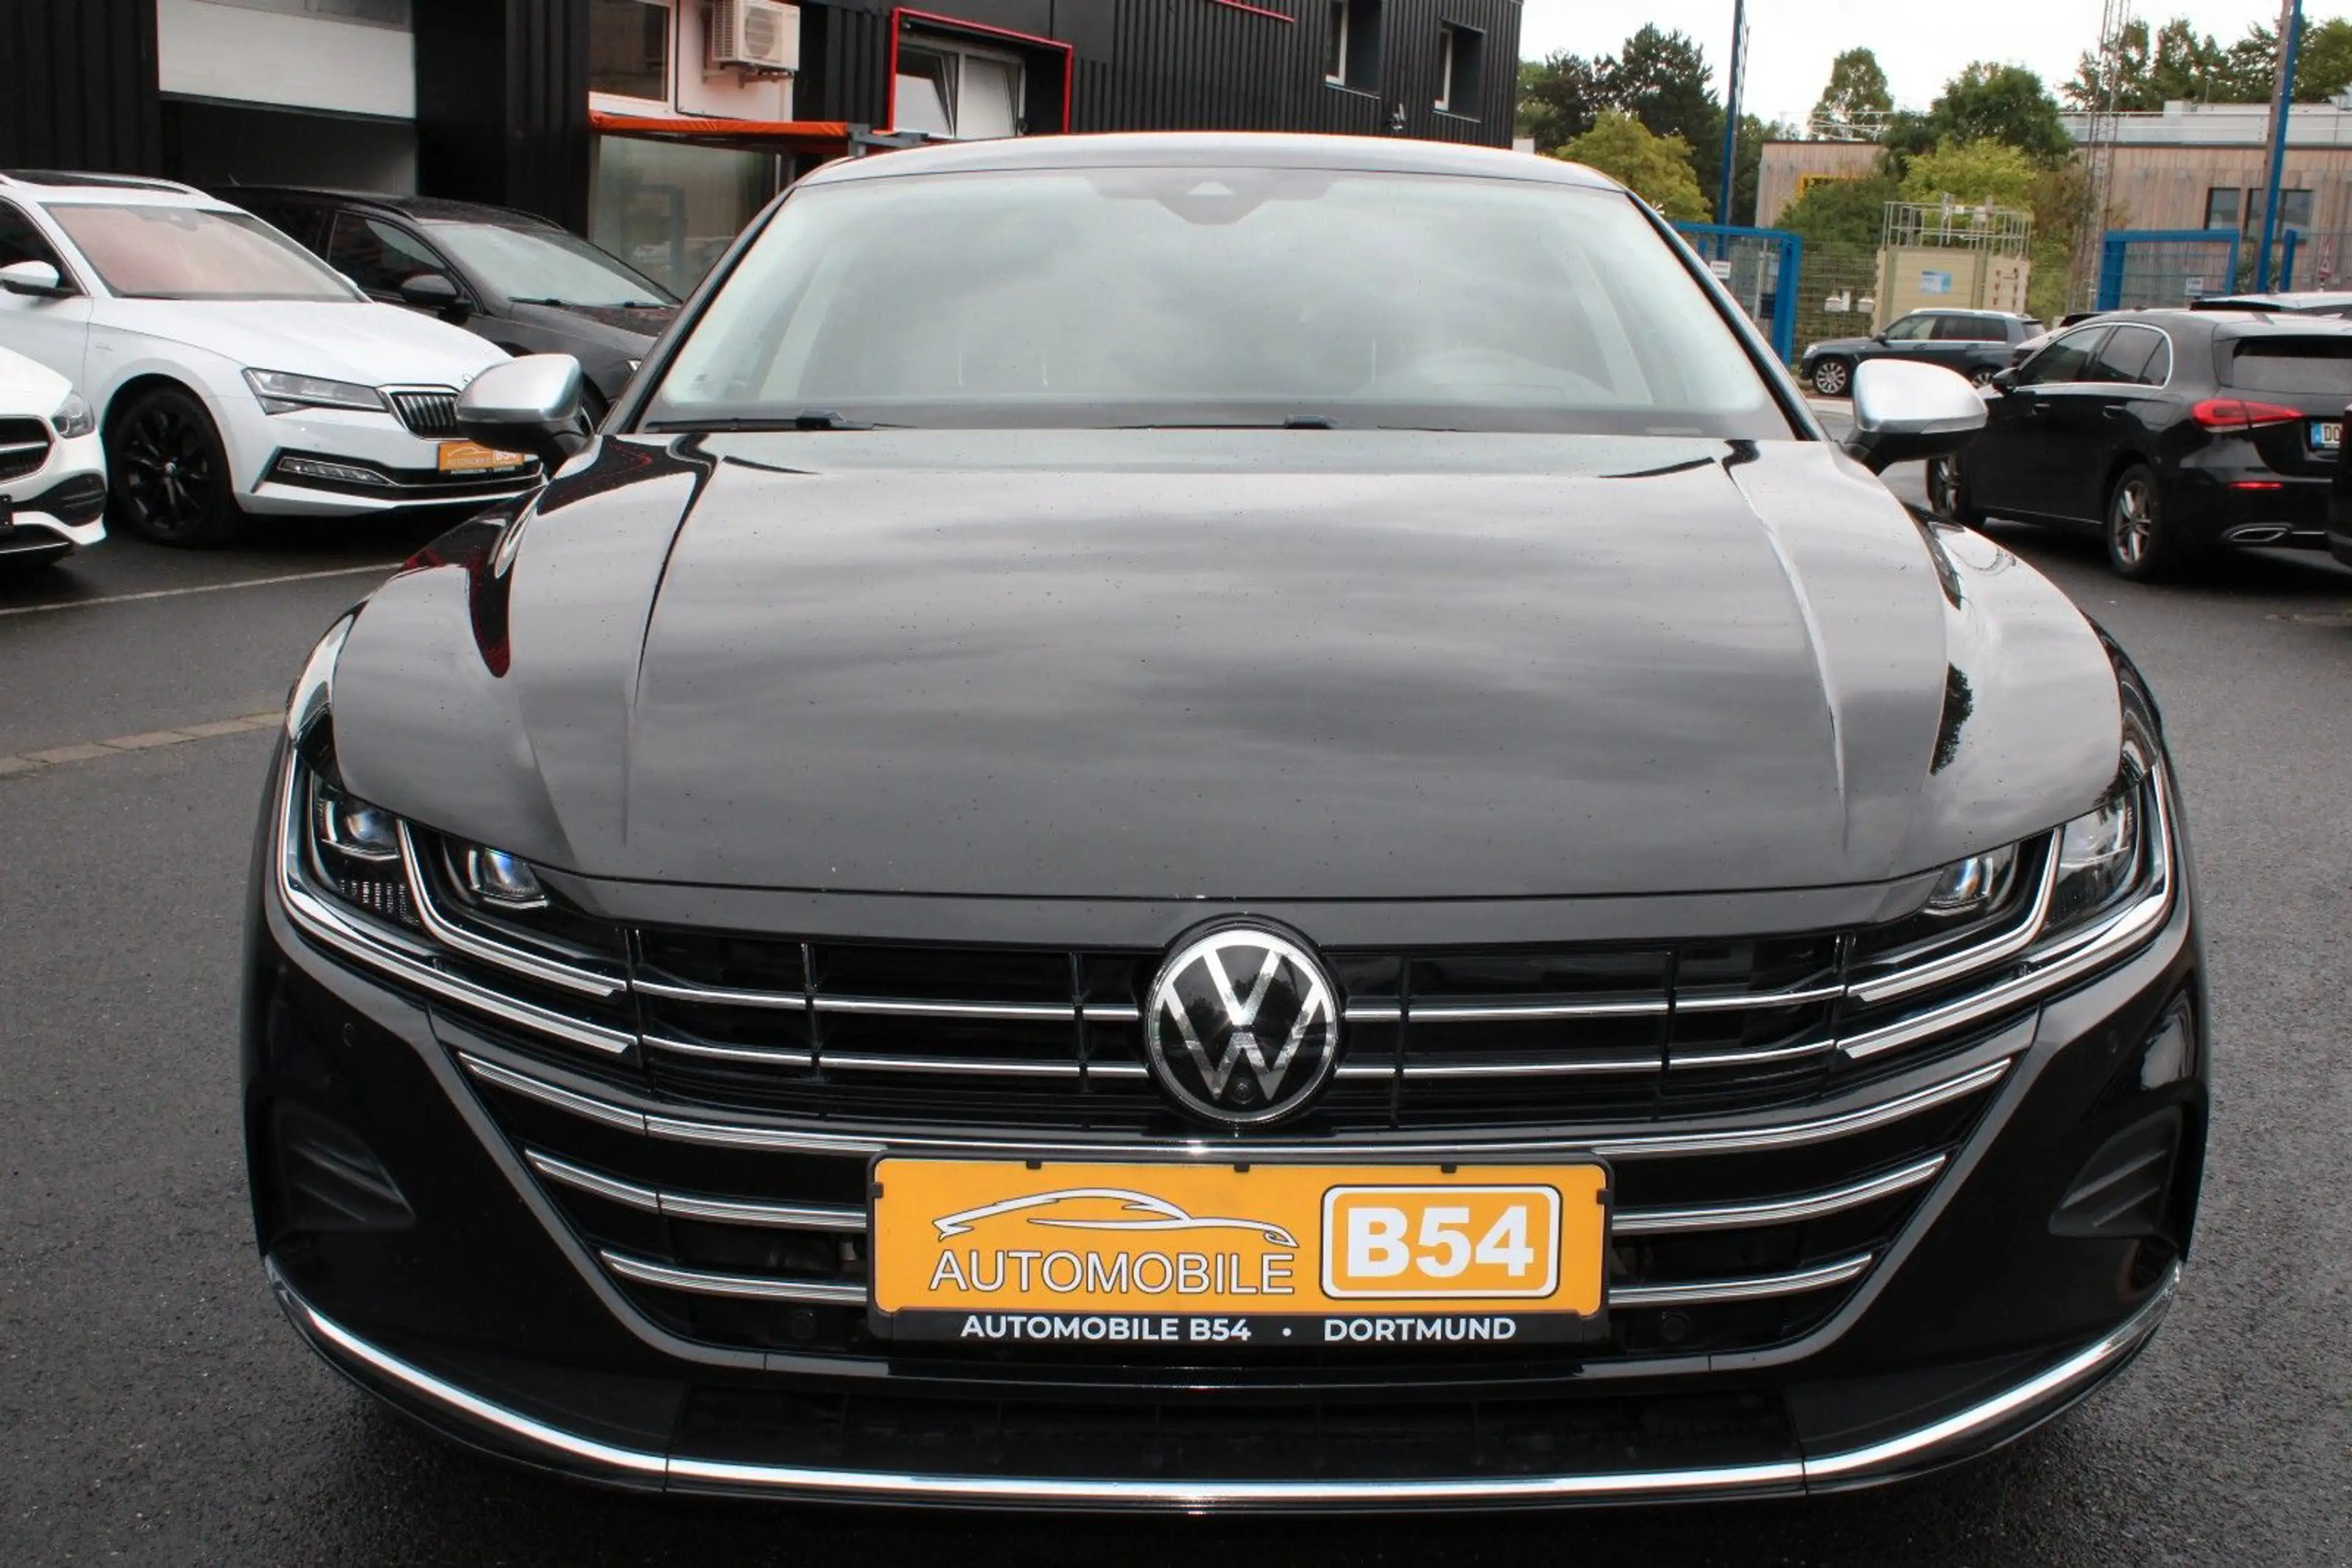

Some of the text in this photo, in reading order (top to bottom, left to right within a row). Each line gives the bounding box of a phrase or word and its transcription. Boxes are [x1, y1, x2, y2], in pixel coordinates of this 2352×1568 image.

[1348, 1205, 1534, 1278] B54
[929, 1249, 1295, 1294] AUTOMOBILE
[960, 1314, 1252, 1341] AUTOMOBILE B54
[1324, 1317, 1517, 1341] DORTMUND
